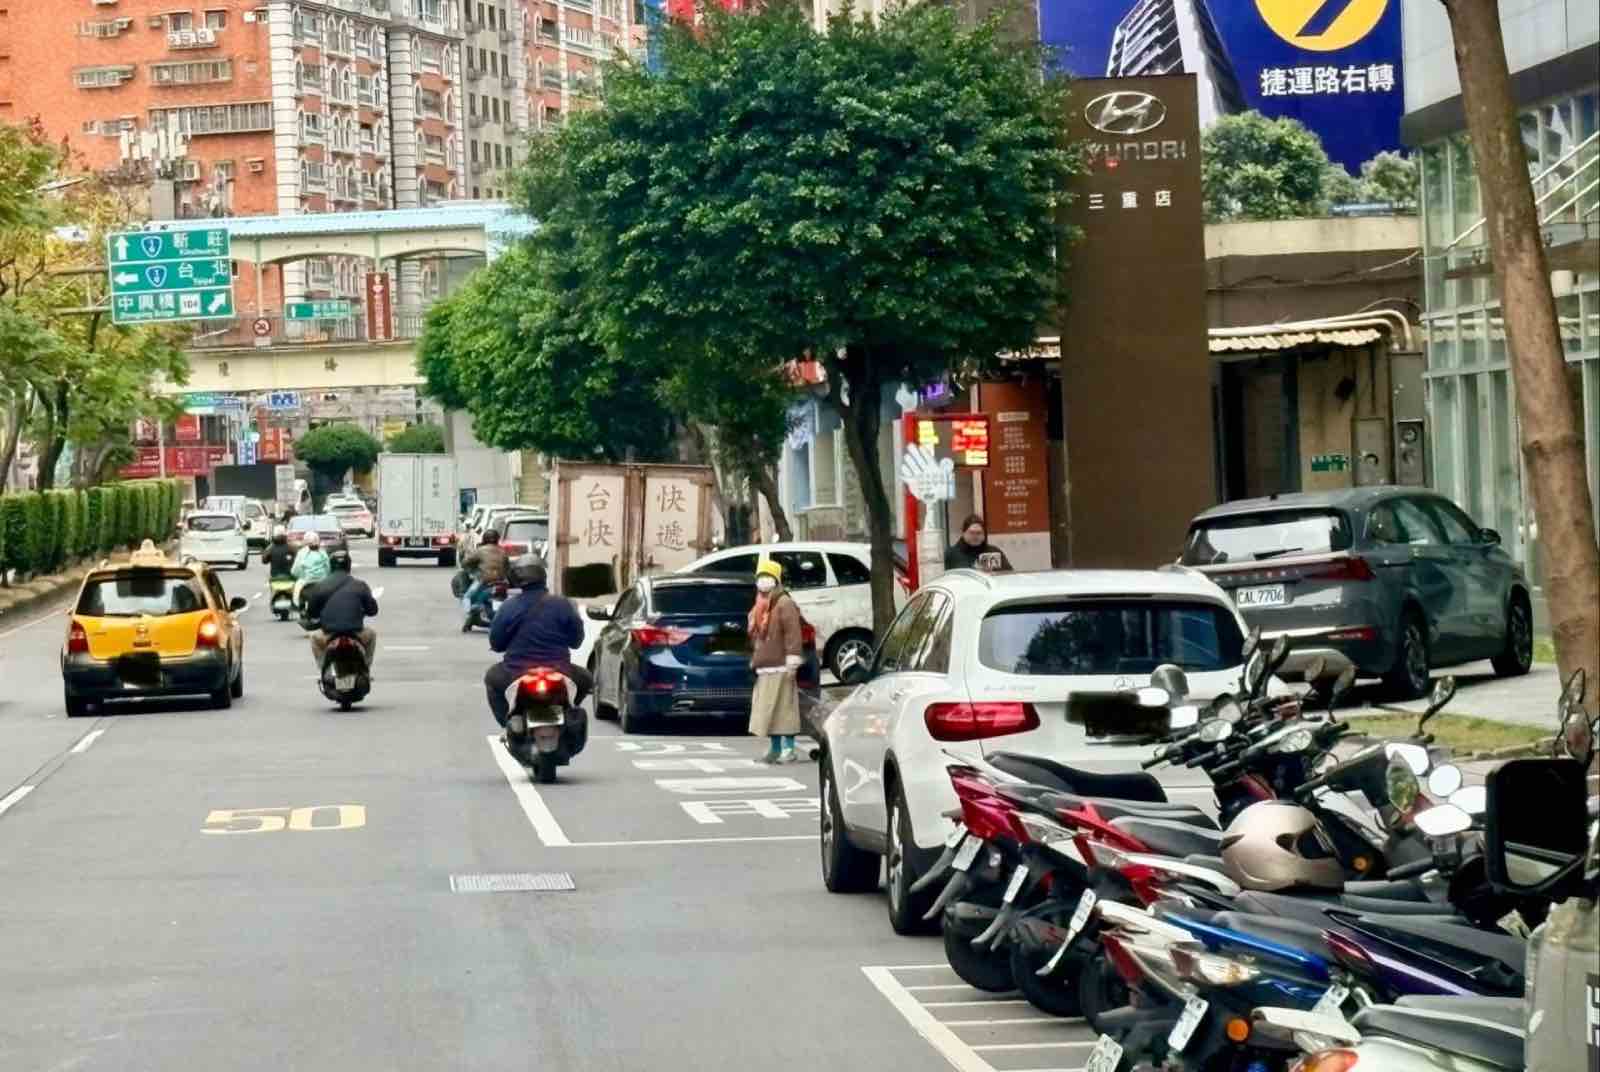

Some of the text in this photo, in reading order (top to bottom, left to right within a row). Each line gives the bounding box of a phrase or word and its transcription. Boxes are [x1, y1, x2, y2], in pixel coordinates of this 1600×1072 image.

[1260, 64, 1395, 97] 捷運路右轉
[200, 805, 366, 835] 50
